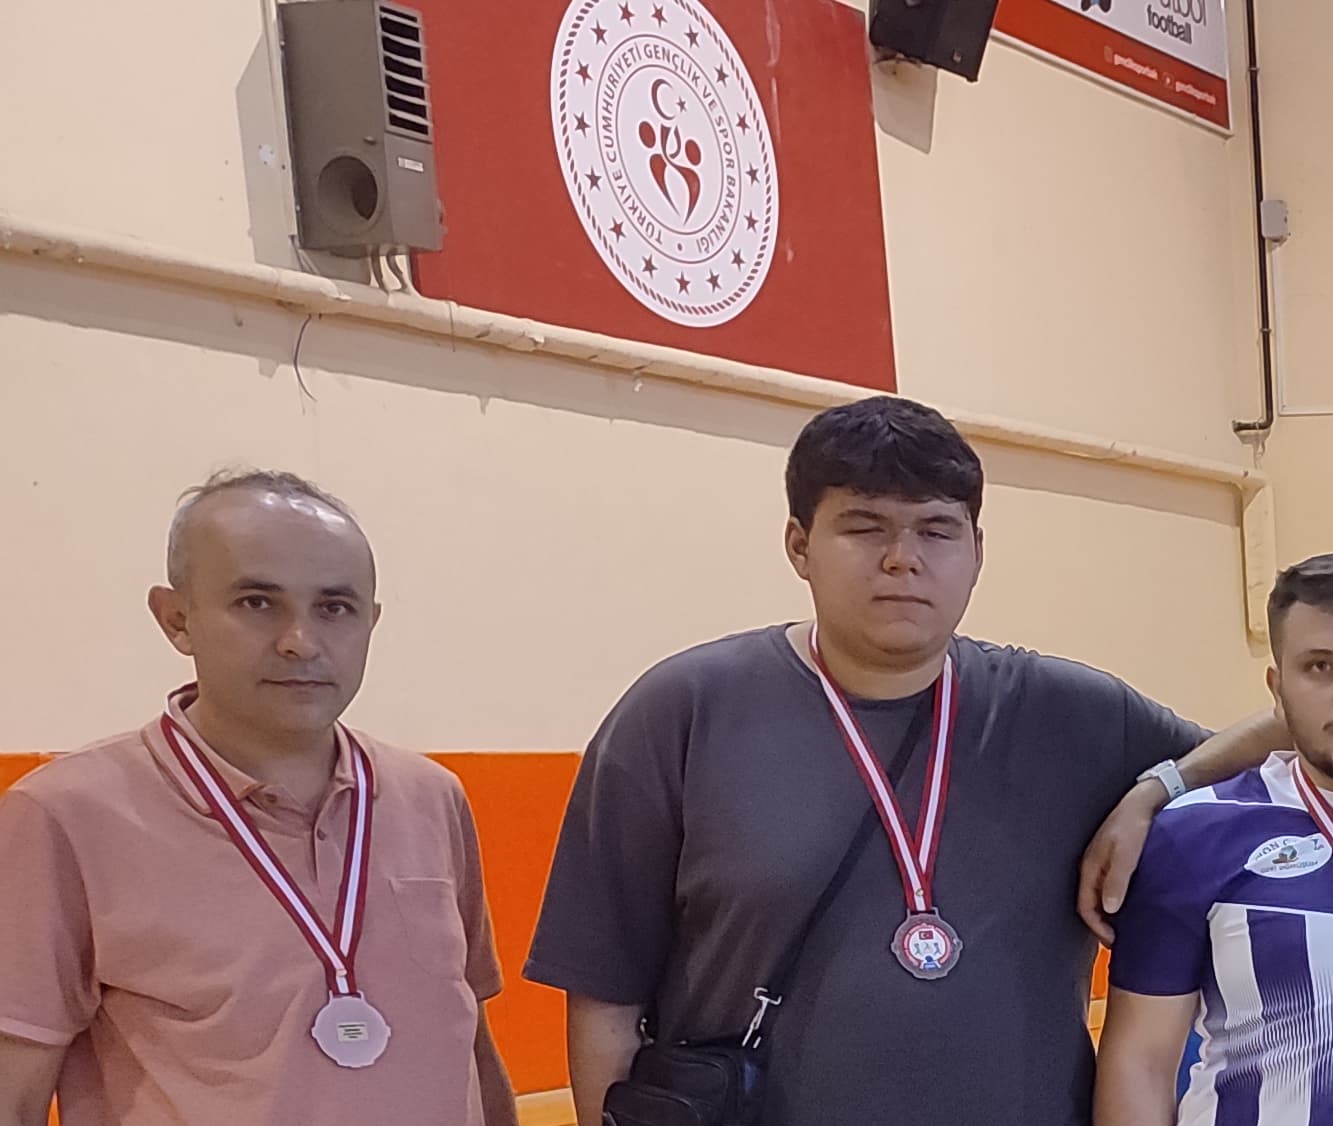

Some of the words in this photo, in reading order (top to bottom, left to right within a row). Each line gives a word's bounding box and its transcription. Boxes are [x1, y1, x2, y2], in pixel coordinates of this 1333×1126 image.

[1147, 4, 1192, 44] football
[702, 85, 717, 112] VE
[715, 117, 735, 169] SPOR
